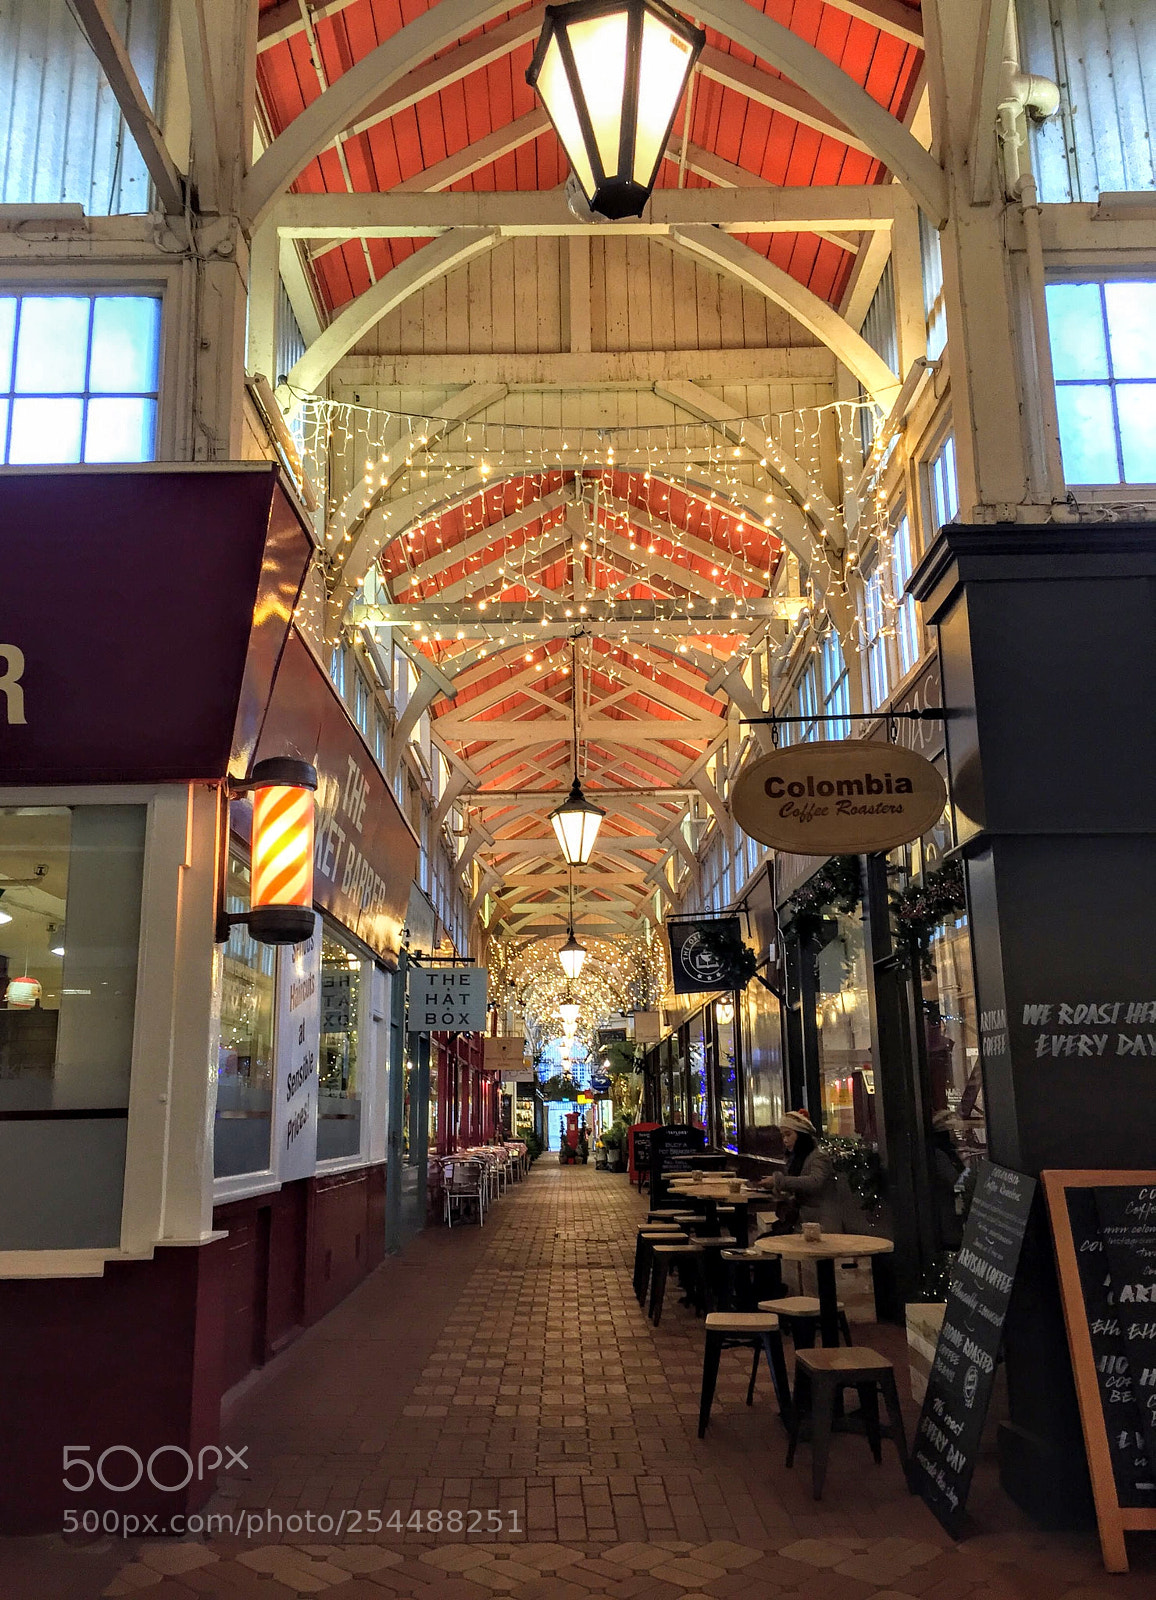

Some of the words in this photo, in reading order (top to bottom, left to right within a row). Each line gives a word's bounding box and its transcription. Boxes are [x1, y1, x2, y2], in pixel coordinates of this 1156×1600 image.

[342, 754, 370, 834] THE
[764, 773, 914, 799] Colombia
[778, 801, 829, 823] Coffee
[835, 799, 905, 817] Roasters
[341, 842, 387, 914] BARBER
[290, 972, 315, 1012] Haircuts
[426, 974, 471, 986] THE
[425, 993, 471, 1005] HAT
[1022, 1003, 1054, 1026] WE
[1058, 1002, 1125, 1025] ROAST
[298, 1018, 306, 1045] at
[425, 1013, 470, 1025] BOX
[1035, 1033, 1109, 1058] EVERY
[287, 1050, 314, 1102] Sensible
[286, 1093, 310, 1150] Prices!
[957, 1247, 989, 1279] ARTISAN
[985, 1265, 1014, 1294] COFFEE
[962, 1336, 994, 1374] ROASTED
[920, 1415, 949, 1453] EVERY
[946, 1443, 967, 1474] DAY
